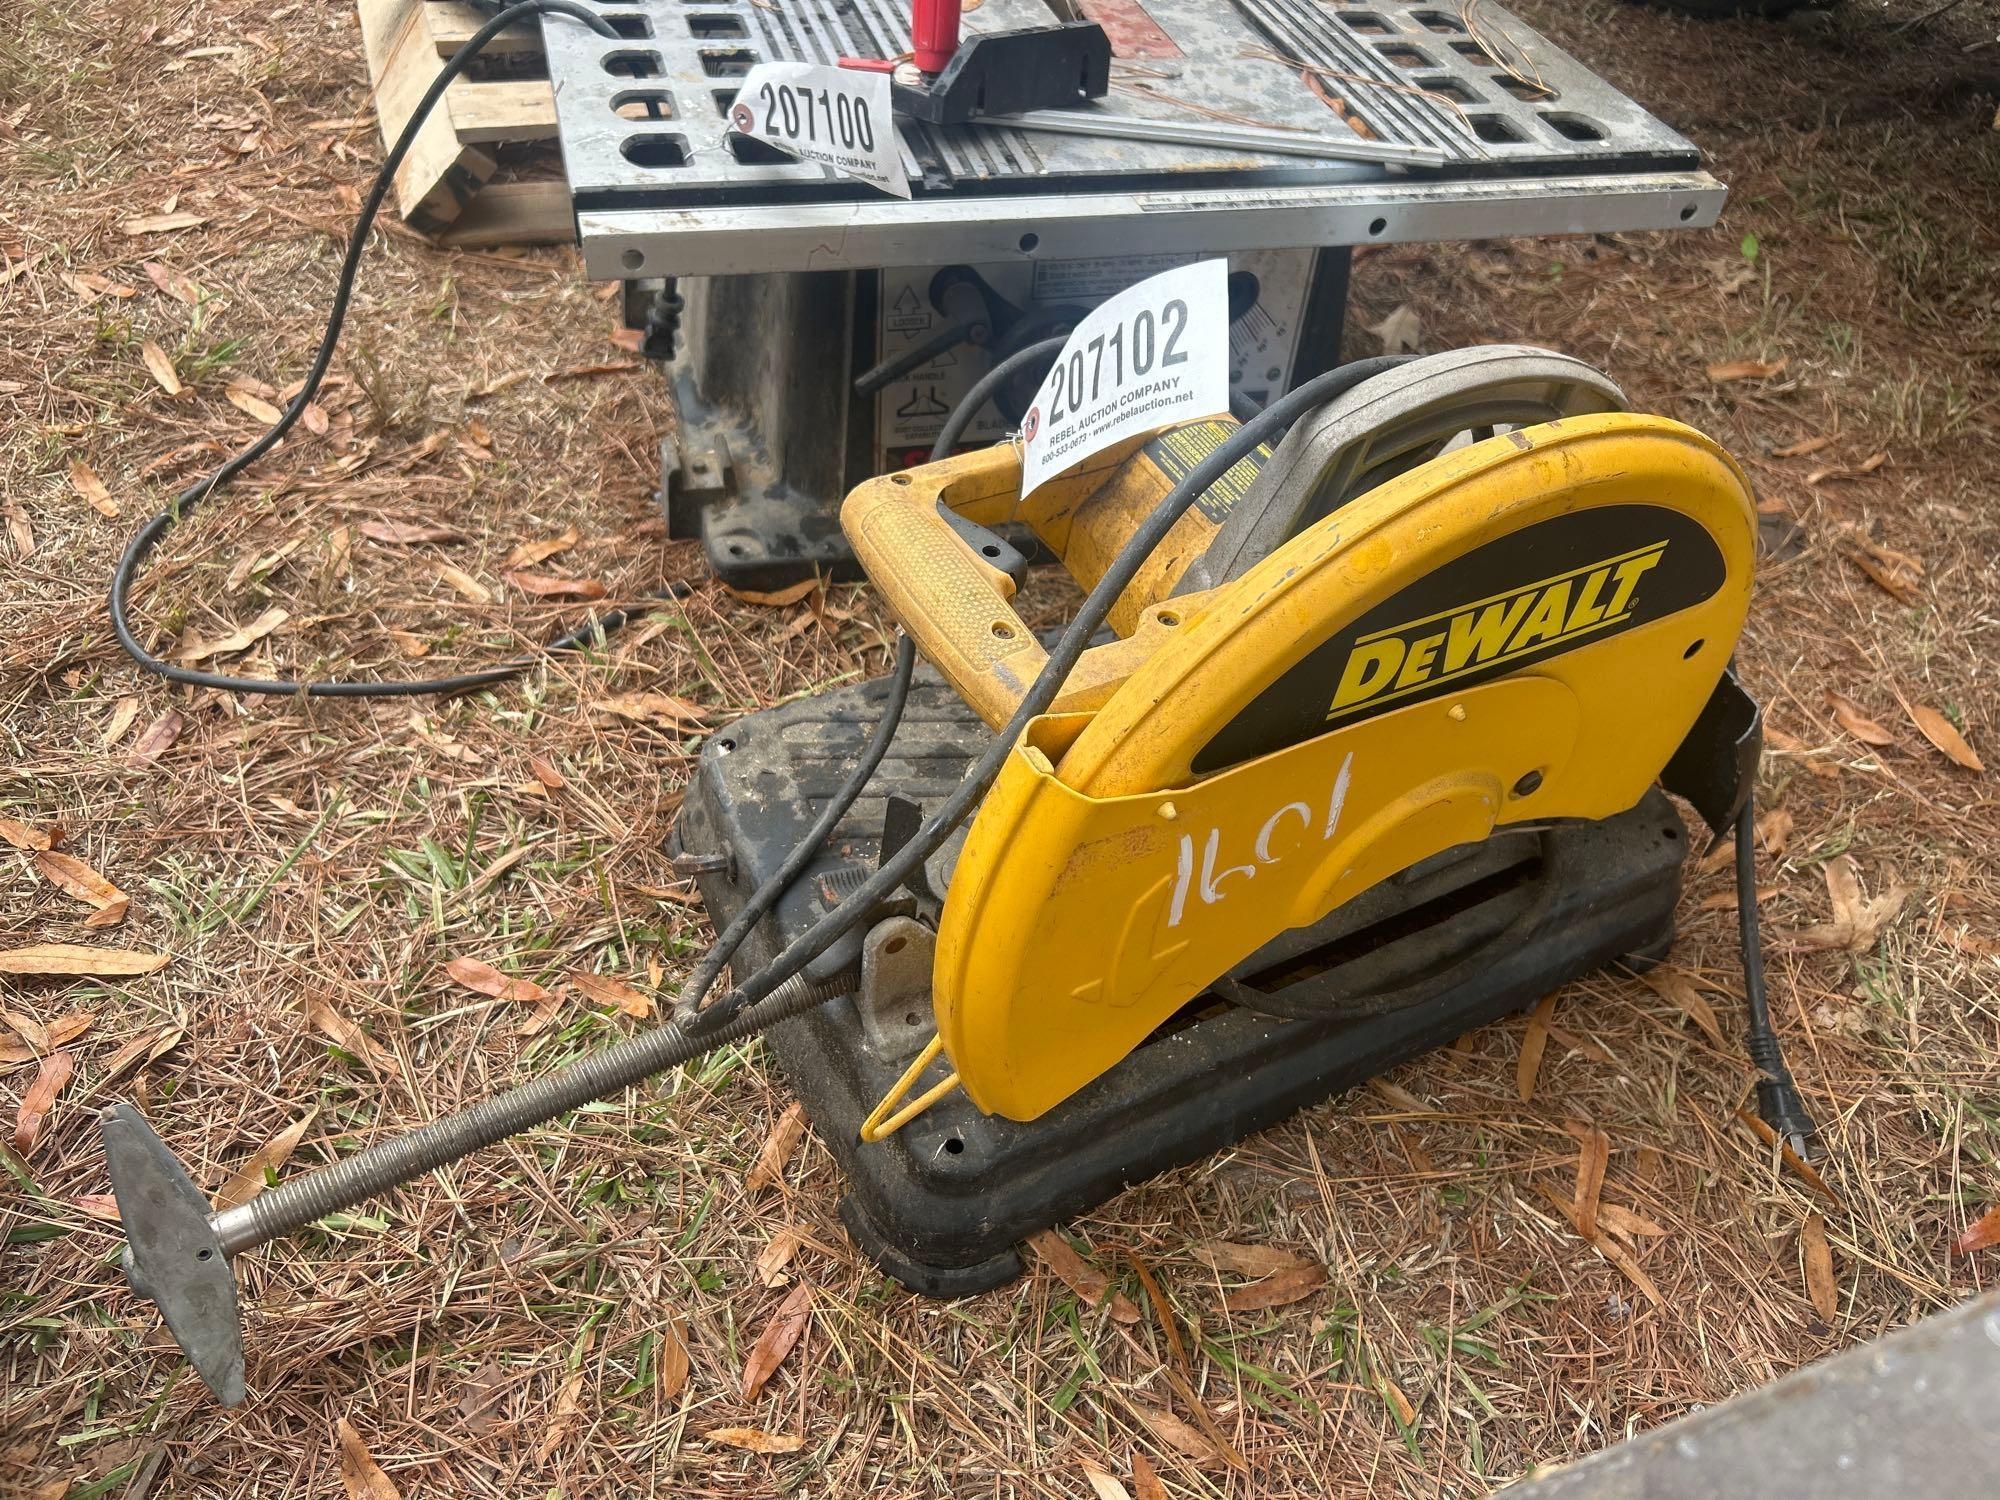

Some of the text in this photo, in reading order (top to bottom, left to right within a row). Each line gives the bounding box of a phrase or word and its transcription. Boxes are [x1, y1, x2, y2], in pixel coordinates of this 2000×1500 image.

[760, 82, 874, 153] 207100
[836, 155, 877, 171] COMPANY
[1049, 298, 1189, 427] 207102
[1041, 390, 1194, 465] 800-533-0673 www.rebelauction.net
[1049, 376, 1180, 448] REBEL AUCTION COMPANY
